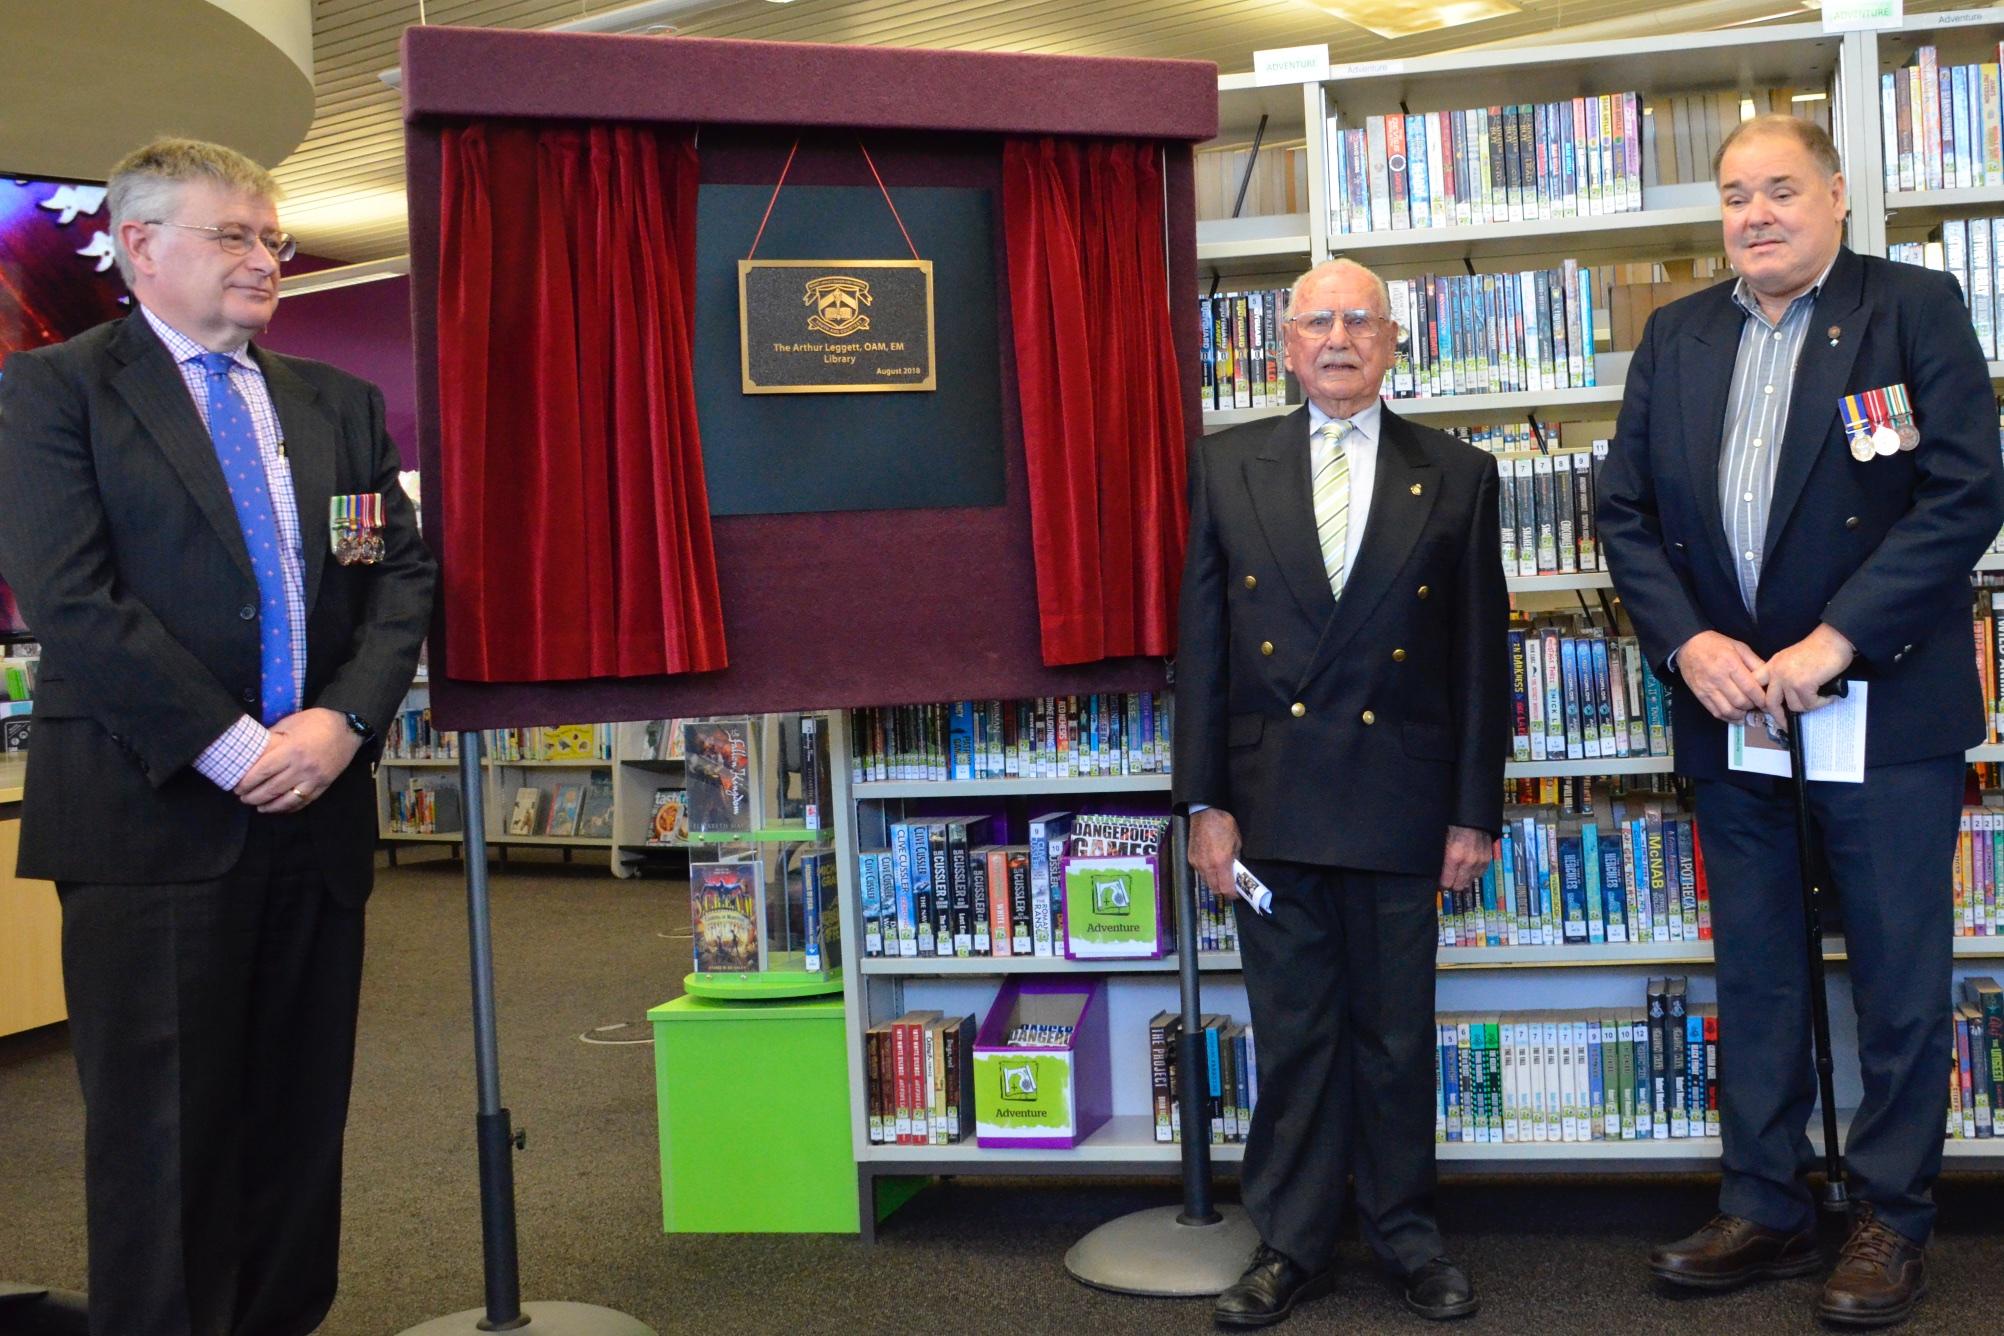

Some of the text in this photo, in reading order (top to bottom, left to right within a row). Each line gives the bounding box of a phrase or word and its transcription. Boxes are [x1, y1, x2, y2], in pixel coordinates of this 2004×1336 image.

[1938, 13, 1983, 24] Adventure
[1266, 58, 1316, 71] ADVENTURE
[1347, 64, 1388, 73] Adventure
[773, 343, 904, 354] The Arthur Leggett, OAM, EM
[823, 354, 856, 365] Library
[876, 367, 921, 376] August 2018
[1513, 655, 1523, 693] DARKNESS
[1047, 716, 1055, 745] LIGHTNING
[1059, 714, 1067, 740] NEMESIS
[1073, 822, 1157, 843] DANGEROUS
[882, 857, 891, 873] CLIVE
[897, 830, 909, 892] CLIVE CUSSLER
[914, 827, 927, 874] CLIVE CUSSLER
[1649, 836, 1664, 888] McNAB
[864, 859, 875, 899] CLIVE CUSSLER
[934, 856, 946, 897] CUSSLER
[954, 856, 966, 897] CUSSLER
[1564, 855, 1577, 889] HERCULES
[1605, 853, 1618, 888] HERCULES
[974, 876, 985, 913] CUSSLER
[1015, 873, 1026, 912] CUSSLER
[1086, 923, 1140, 933] Adventure
[1152, 1029, 1167, 1088] THE PROJECT
[995, 1108, 1047, 1118] Adventure
